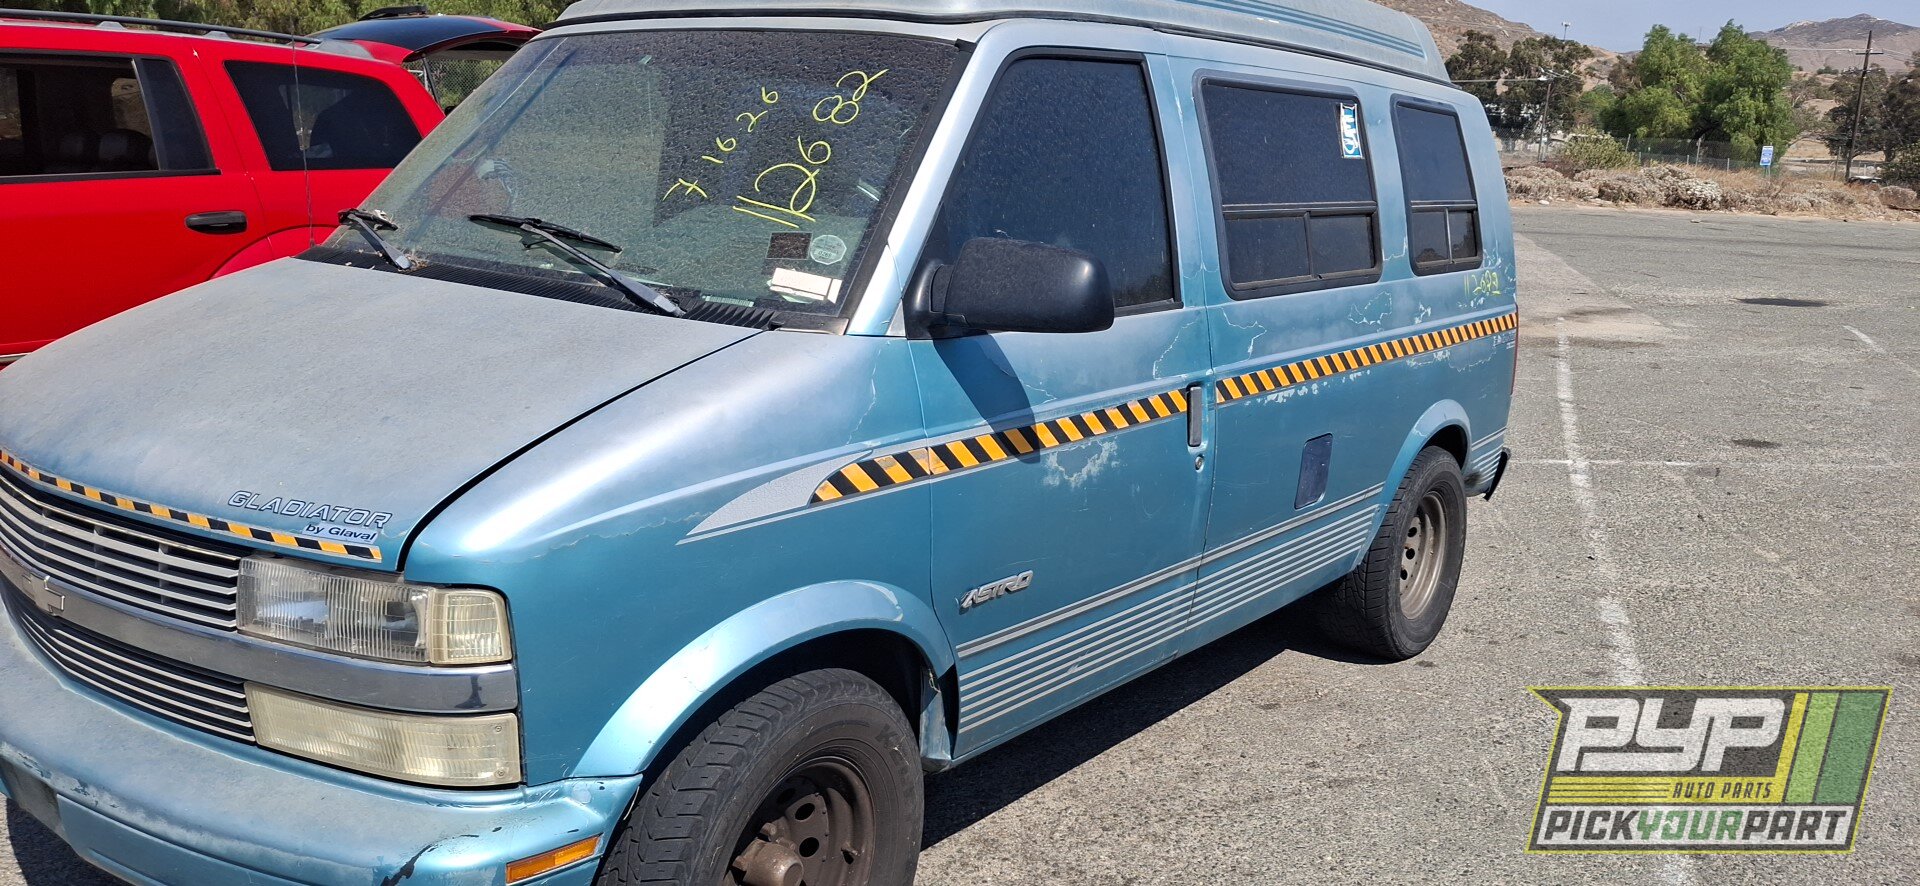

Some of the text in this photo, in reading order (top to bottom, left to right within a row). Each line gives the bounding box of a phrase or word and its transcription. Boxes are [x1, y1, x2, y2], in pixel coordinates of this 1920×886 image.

[662, 177, 708, 201] 7
[735, 86, 779, 133] 26
[732, 68, 890, 228] 112682
[228, 490, 393, 529] GLADIATOR
[305, 523, 377, 542] by Glaval
[960, 569, 1034, 609] ASTRO
